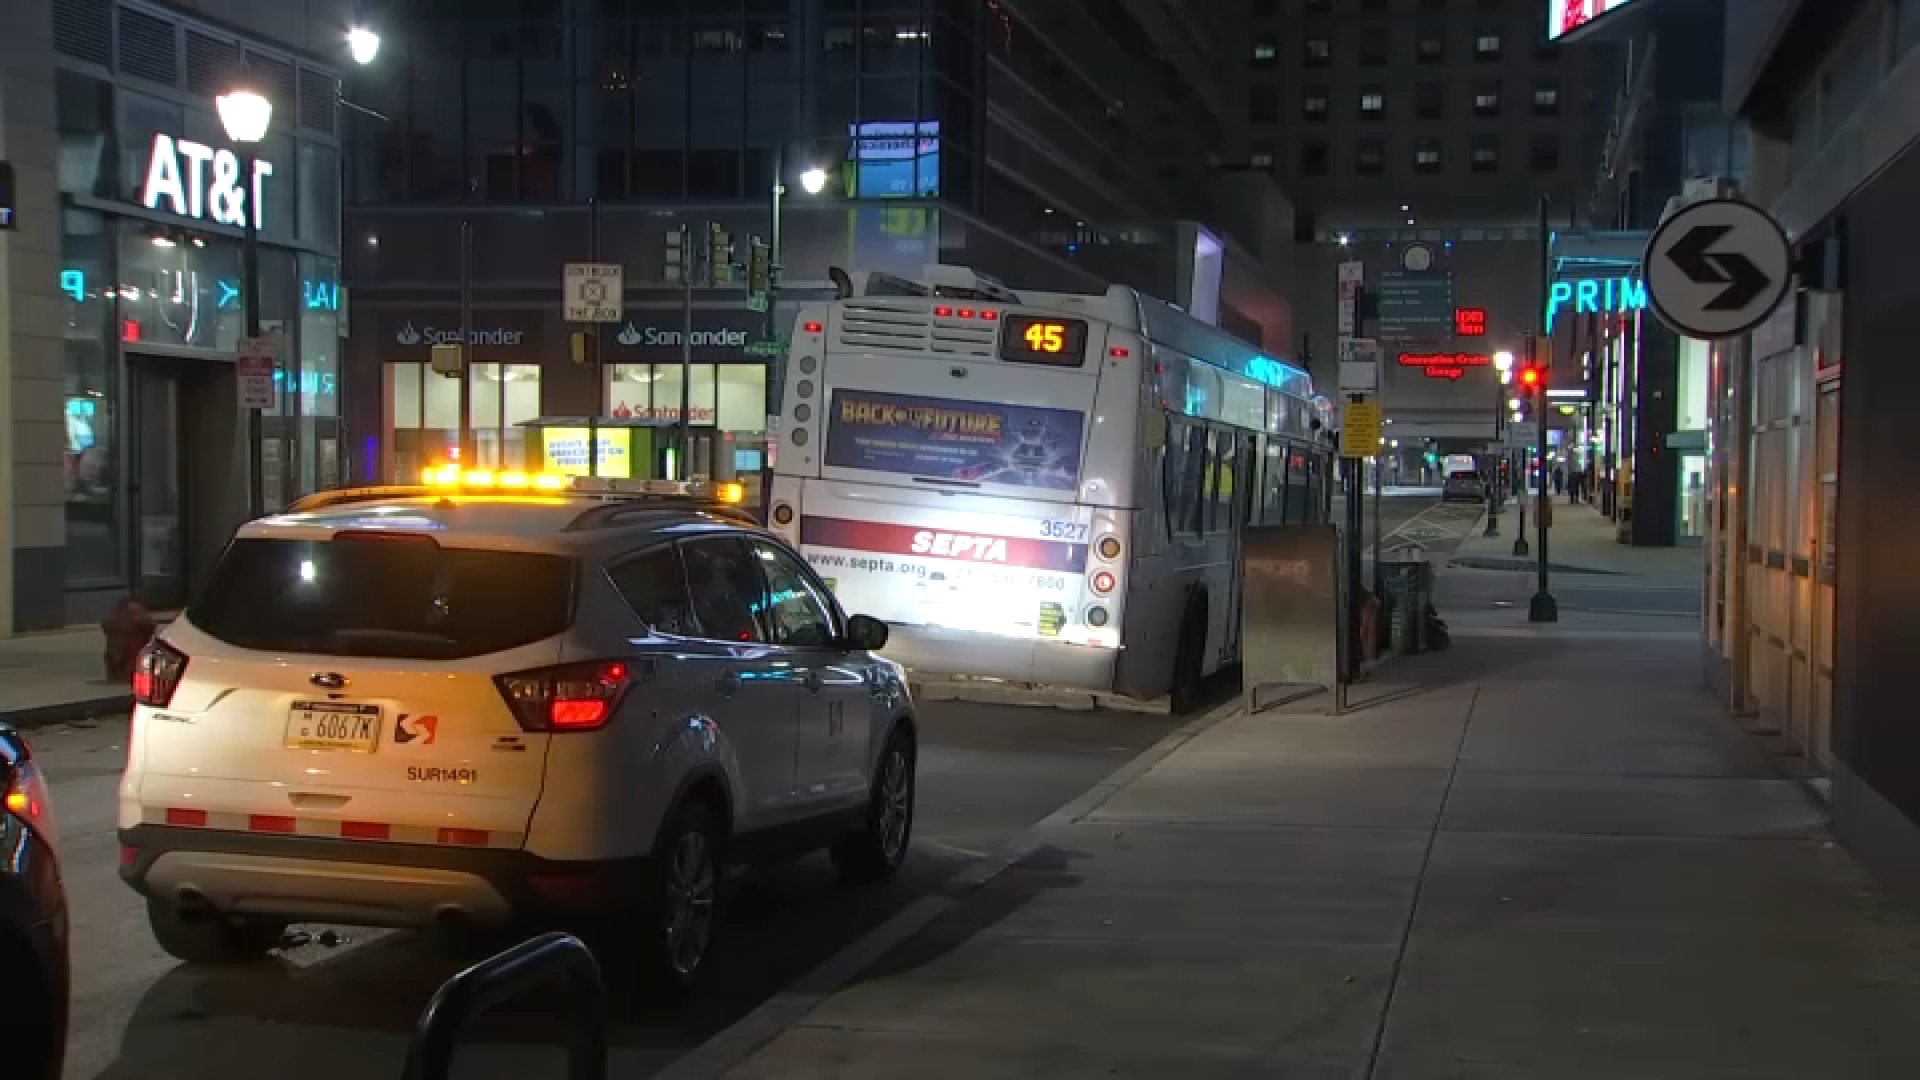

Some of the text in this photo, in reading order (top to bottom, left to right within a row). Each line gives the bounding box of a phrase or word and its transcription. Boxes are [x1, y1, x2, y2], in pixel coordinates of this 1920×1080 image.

[143, 132, 273, 230] AT&T
[645, 327, 748, 345] Sanander
[1026, 323, 1064, 353] 45
[1039, 519, 1089, 540] 3527
[911, 531, 1006, 561] SEPTA
[808, 552, 926, 578] www.septa.org
